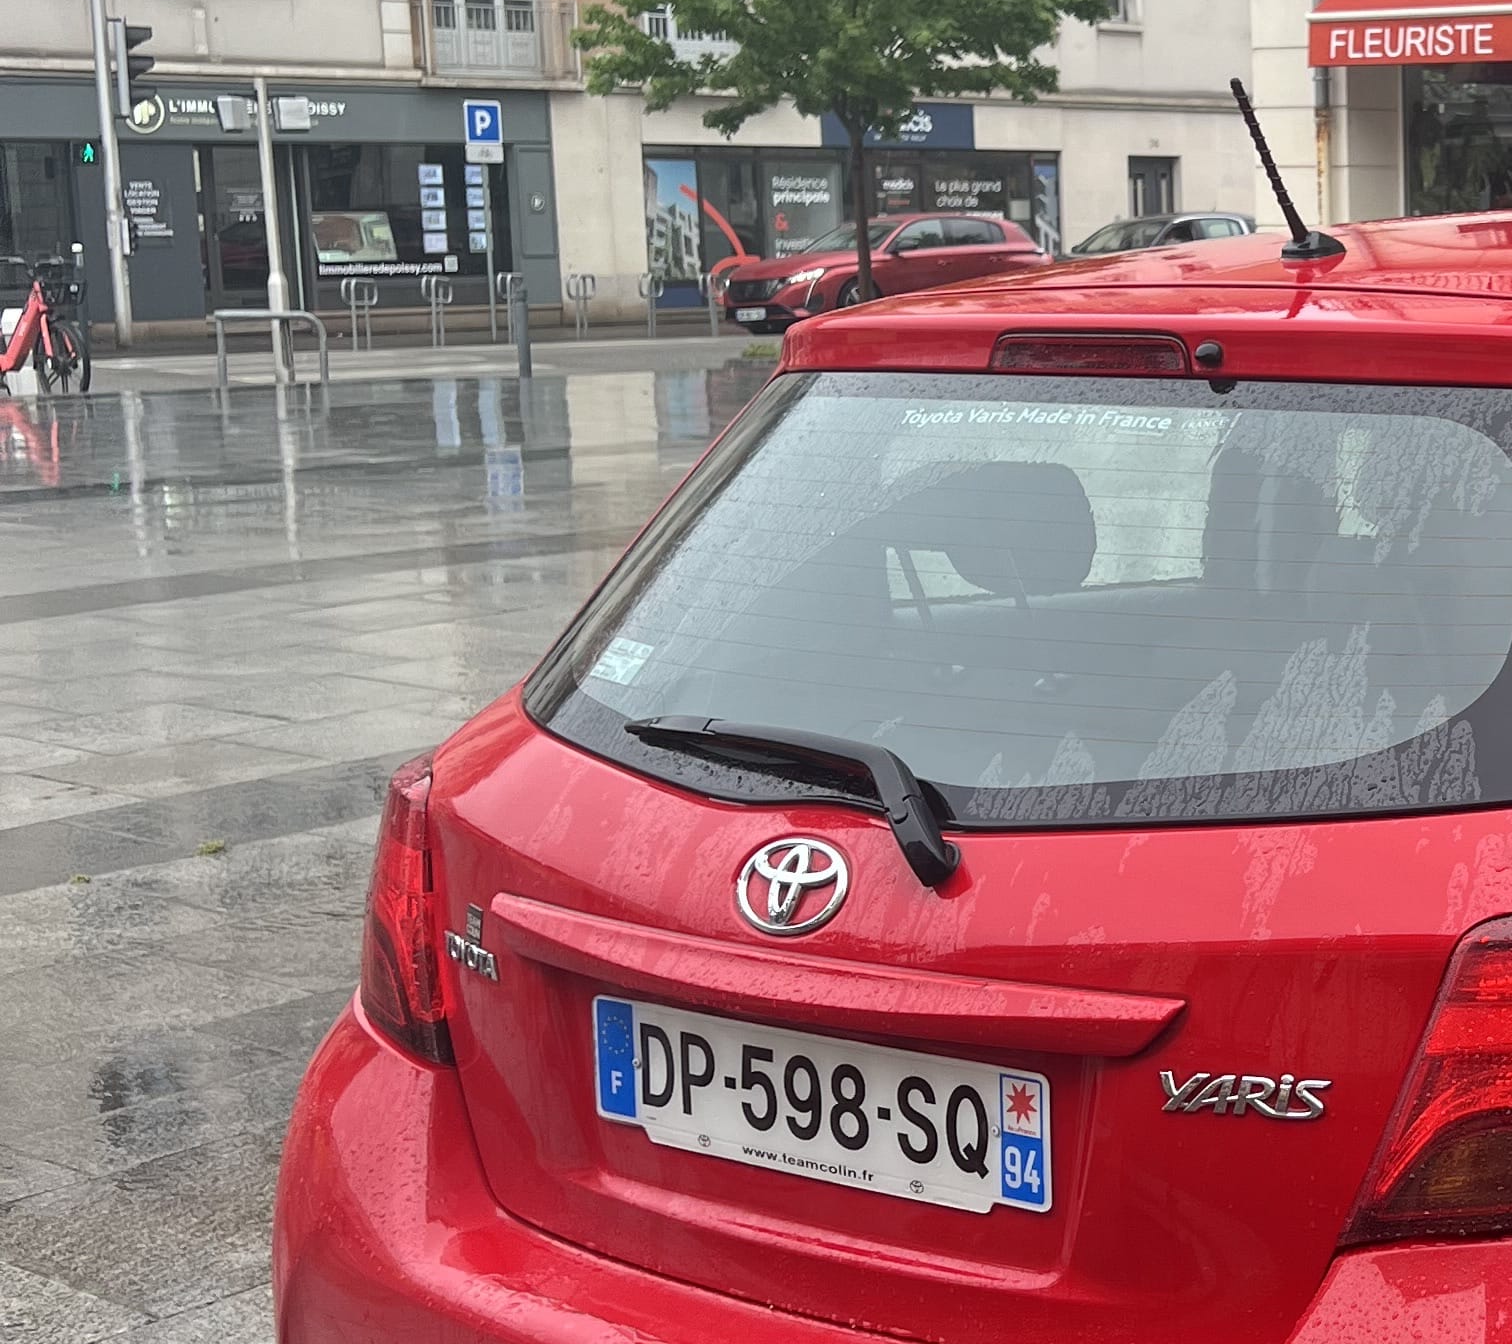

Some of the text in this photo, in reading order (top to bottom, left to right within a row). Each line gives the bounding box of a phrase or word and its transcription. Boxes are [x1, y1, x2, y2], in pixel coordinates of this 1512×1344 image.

[1330, 23, 1494, 59] FLEURISTE
[475, 109, 491, 136] P
[901, 407, 1172, 430] Toyota Yaris Made in France
[611, 1070, 622, 1094] F
[640, 1022, 989, 1179] DP-598-SQ
[742, 1144, 874, 1184] www.teamcolin.fr
[1004, 1146, 1041, 1194] 94
